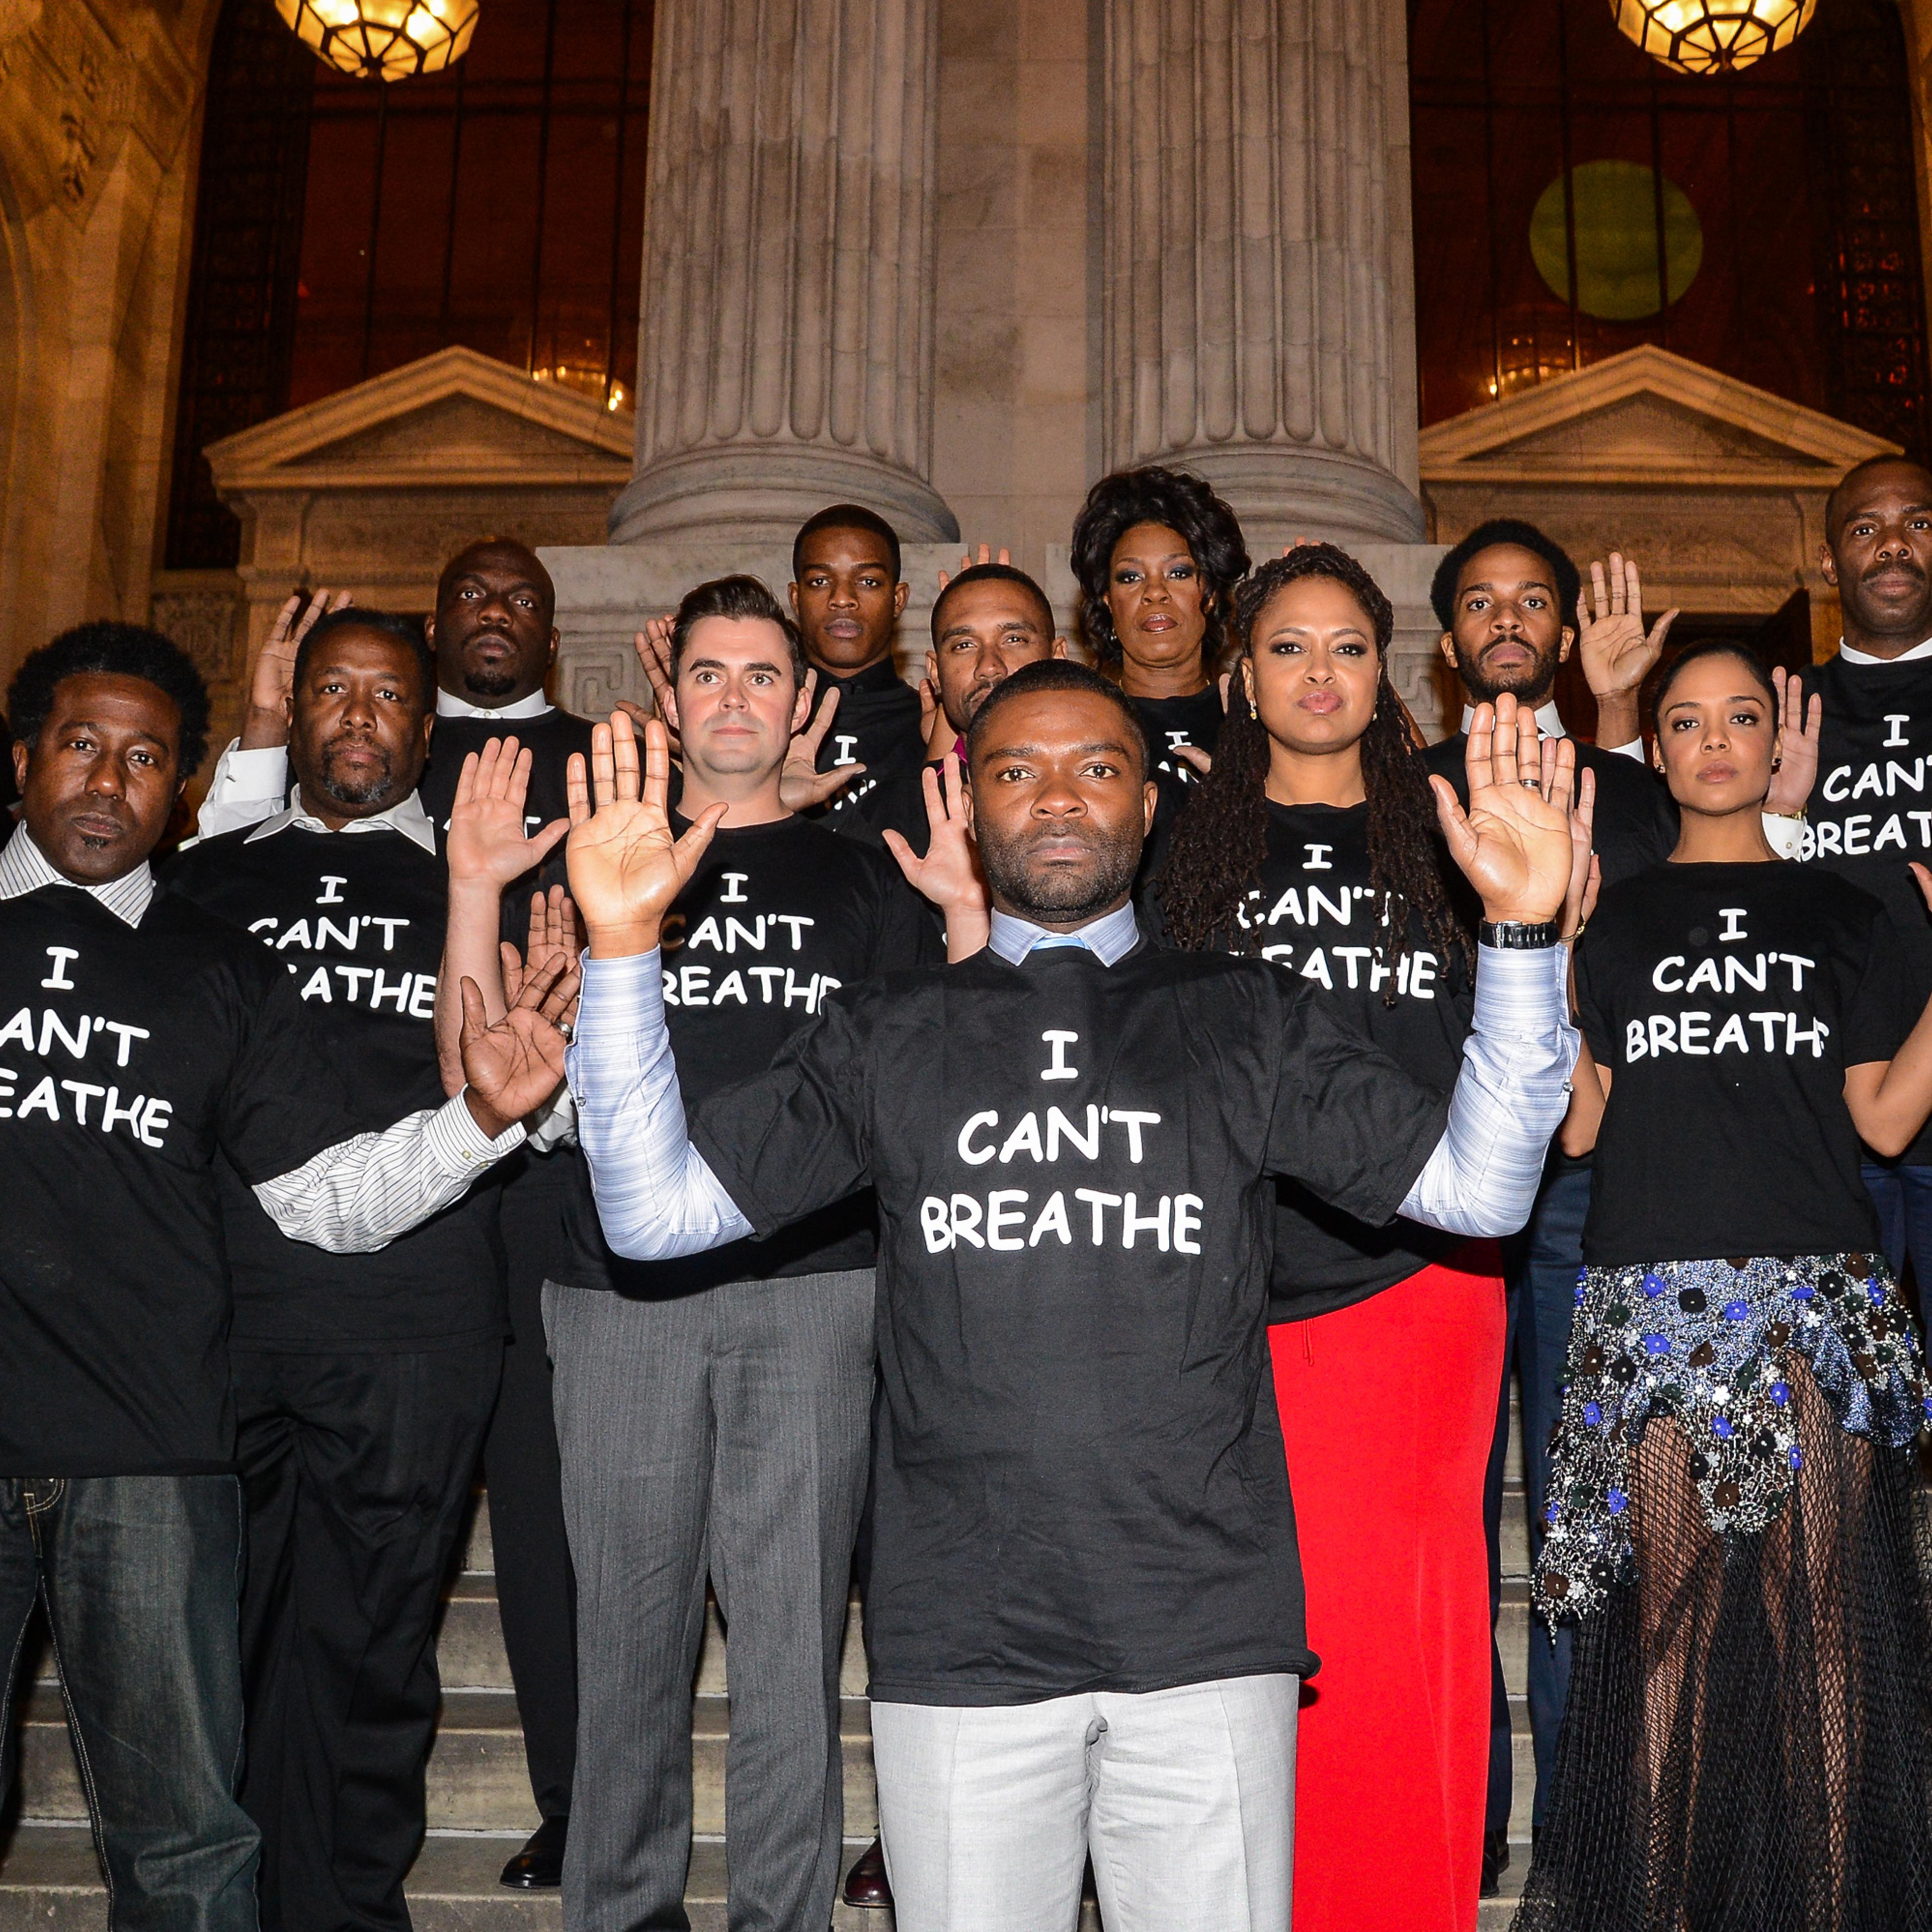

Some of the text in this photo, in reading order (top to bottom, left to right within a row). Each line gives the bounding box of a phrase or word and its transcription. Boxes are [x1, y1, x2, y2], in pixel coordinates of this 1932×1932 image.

[834, 735, 858, 765] I
[1165, 731, 1192, 750] I
[1883, 714, 1910, 747] I
[1822, 754, 1932, 802] CAN'
[1302, 844, 1333, 869] I
[1801, 811, 1931, 862] BREAT
[315, 875, 348, 904] I
[720, 872, 749, 903] I
[1718, 908, 1748, 941] I
[41, 946, 79, 990] I
[1652, 951, 1815, 994] CAN'T
[287, 964, 437, 1018] ATHE
[662, 965, 842, 1016] REATH
[0, 1007, 150, 1067] AN'T
[1040, 1029, 1079, 1081] I
[957, 1103, 1161, 1165] CAN'T
[920, 1187, 1203, 1255] BREATHE
